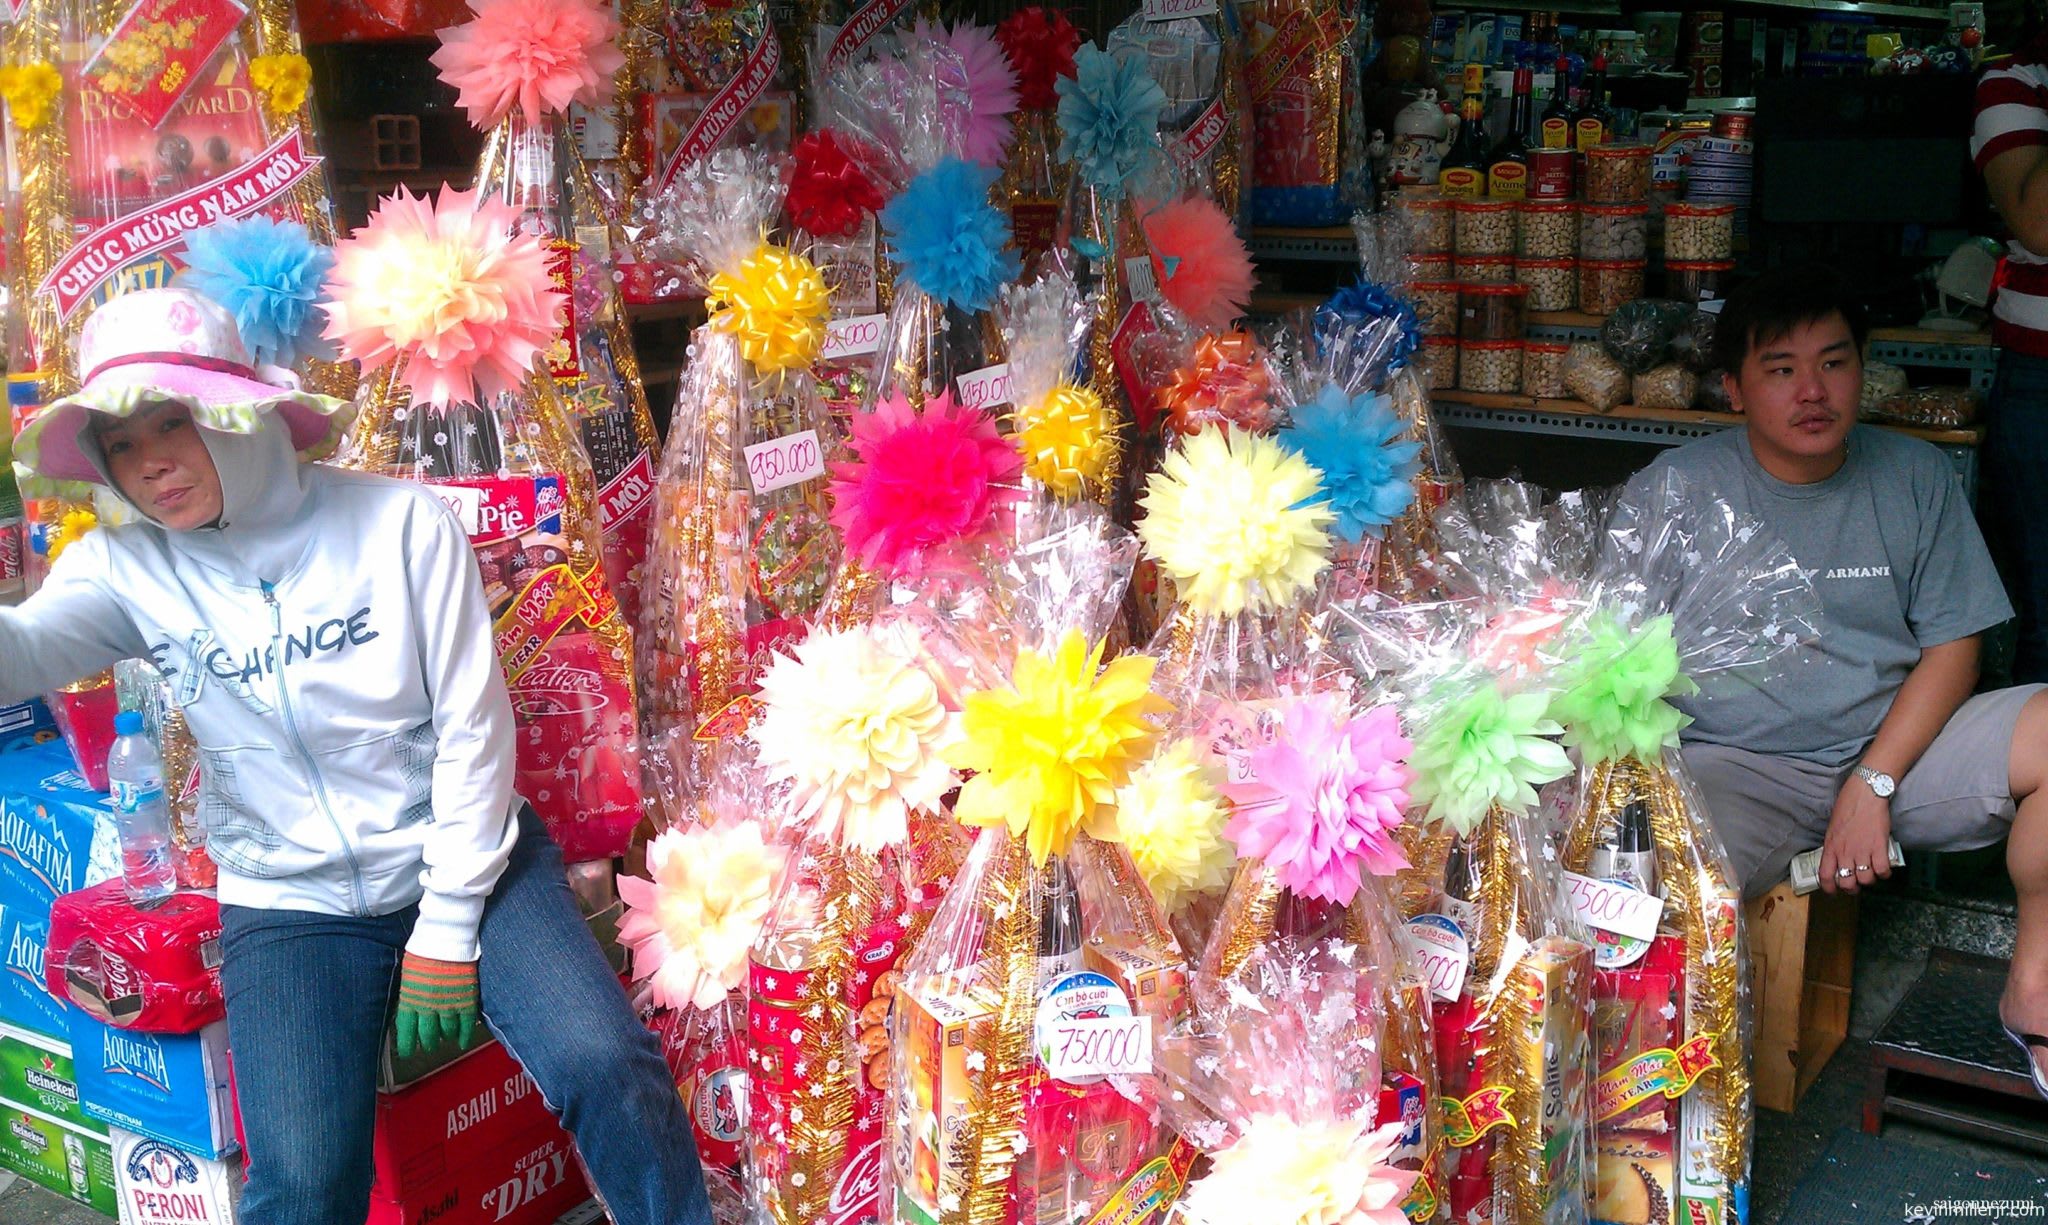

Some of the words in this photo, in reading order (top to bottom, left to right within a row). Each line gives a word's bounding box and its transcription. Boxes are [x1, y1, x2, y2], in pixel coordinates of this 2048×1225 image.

[59, 238, 124, 296] CHÚC
[121, 206, 200, 252] MỪNG
[199, 178, 261, 219] NĂM
[256, 150, 302, 195] MỚI
[751, 438, 816, 489] 950.000
[609, 474, 650, 516] MỚI
[480, 503, 524, 533] Pie
[1826, 566, 1890, 579] ARMANI
[508, 635, 542, 669] YEAR
[103, 1027, 171, 1092] AQUAFINA
[1058, 1019, 1142, 1068] 750000
[27, 1069, 76, 1099] Heineken
[1620, 1079, 1653, 1101] YEAR
[447, 1088, 497, 1139] ASAHI
[12, 1122, 46, 1147] Heineken
[514, 1141, 554, 1174] SUPER
[132, 1188, 208, 1220] PERONI
[1121, 1200, 1150, 1225] EAR
